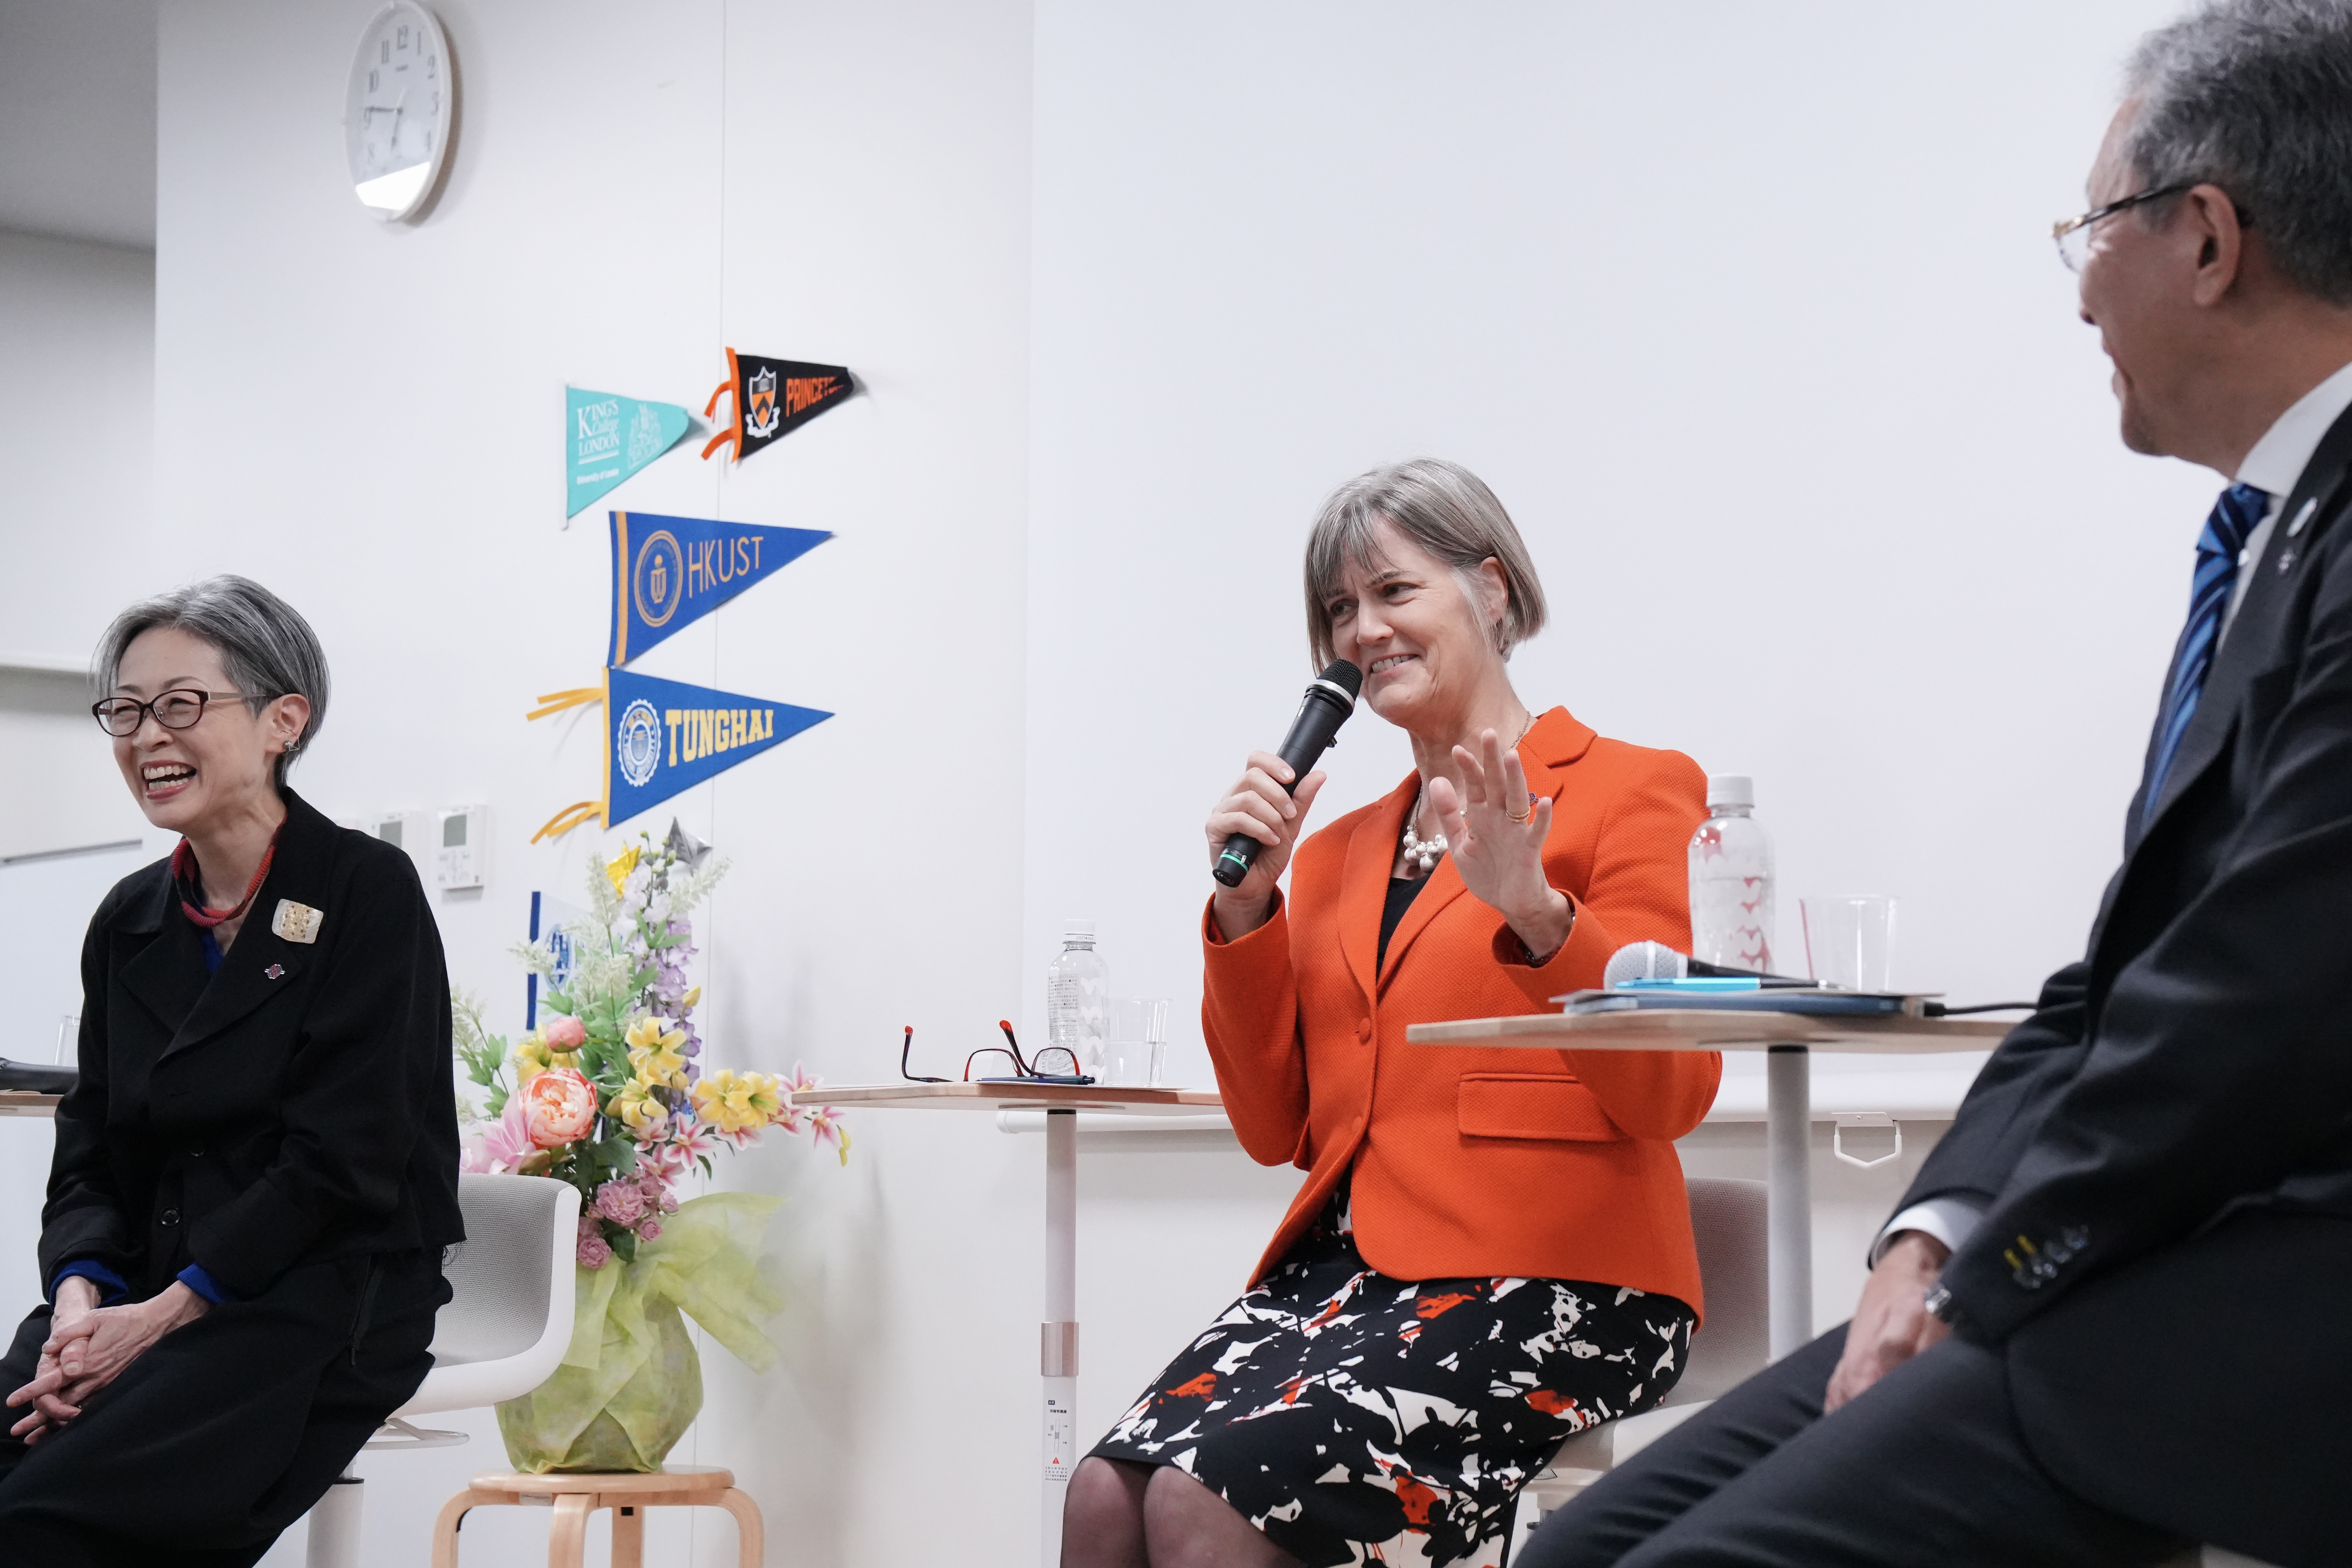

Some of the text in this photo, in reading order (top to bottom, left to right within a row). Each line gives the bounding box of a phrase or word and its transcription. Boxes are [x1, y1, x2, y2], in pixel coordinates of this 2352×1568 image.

[579, 432, 620, 456] LONDON
[689, 536, 763, 598] HKUST
[665, 709, 774, 767] TUNGHAI
